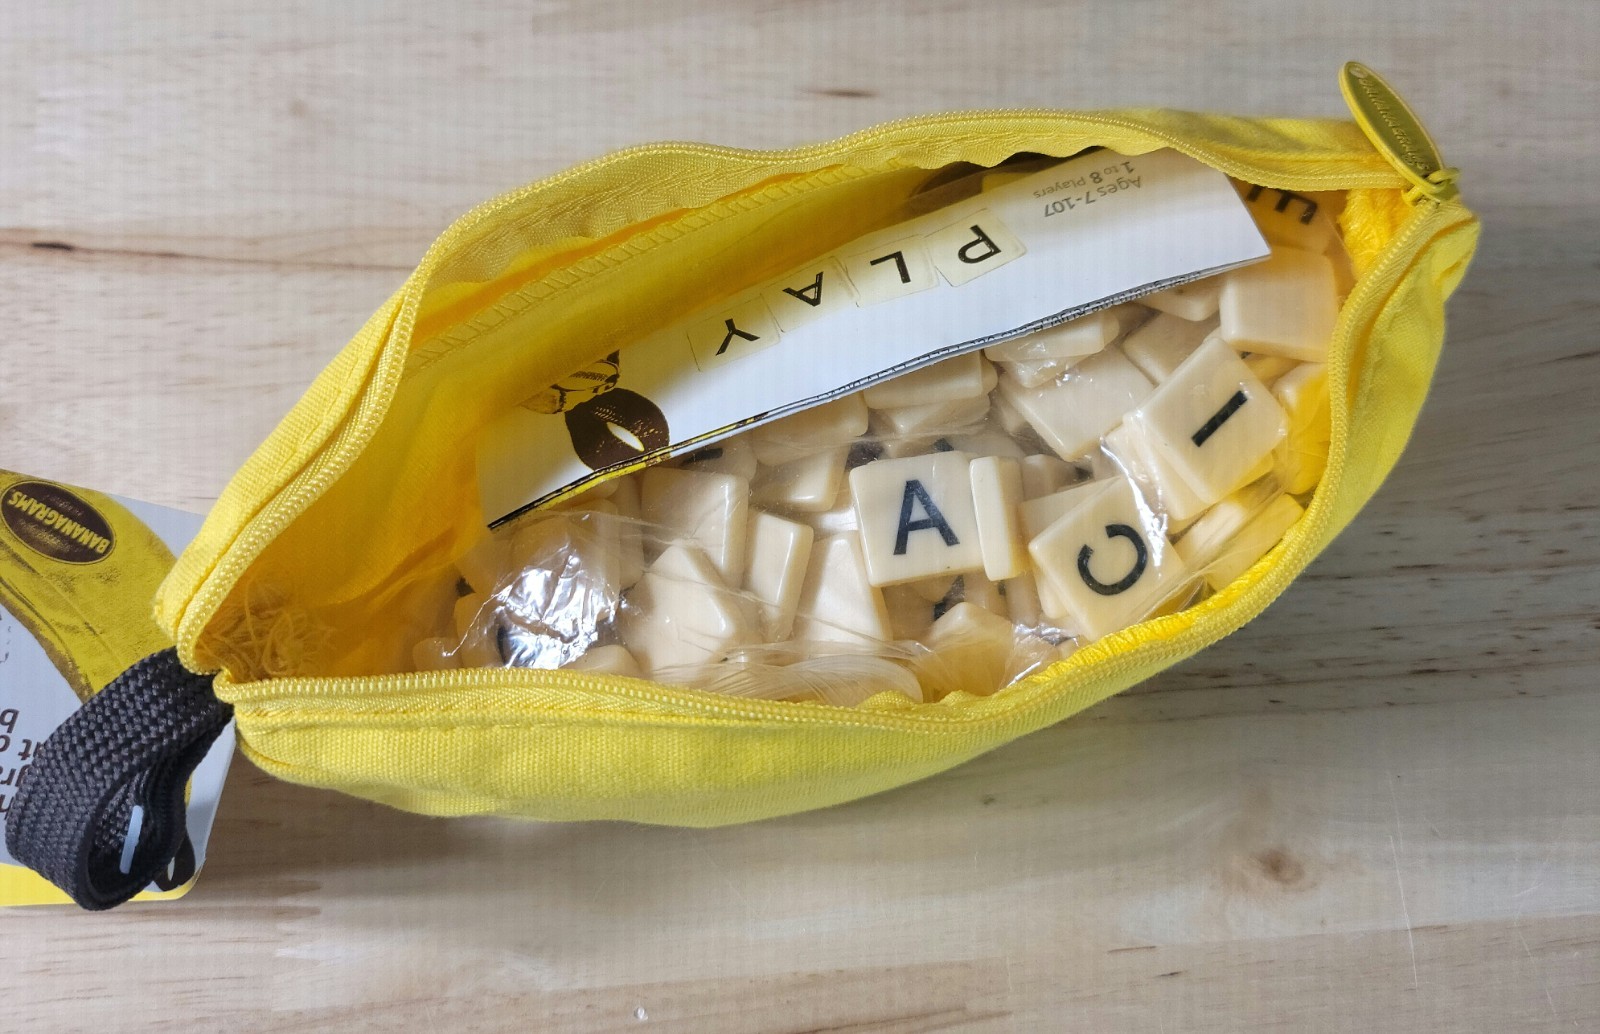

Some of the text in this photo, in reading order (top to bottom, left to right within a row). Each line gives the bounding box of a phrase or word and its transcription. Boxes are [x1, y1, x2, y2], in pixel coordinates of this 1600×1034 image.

[1033, 161, 1134, 199] 1 to 8 Players
[1043, 175, 1141, 218] Ages 7-107
[8, 490, 111, 554] BANANAGRAMS
[892, 478, 961, 556] A
[1076, 522, 1149, 596] C
